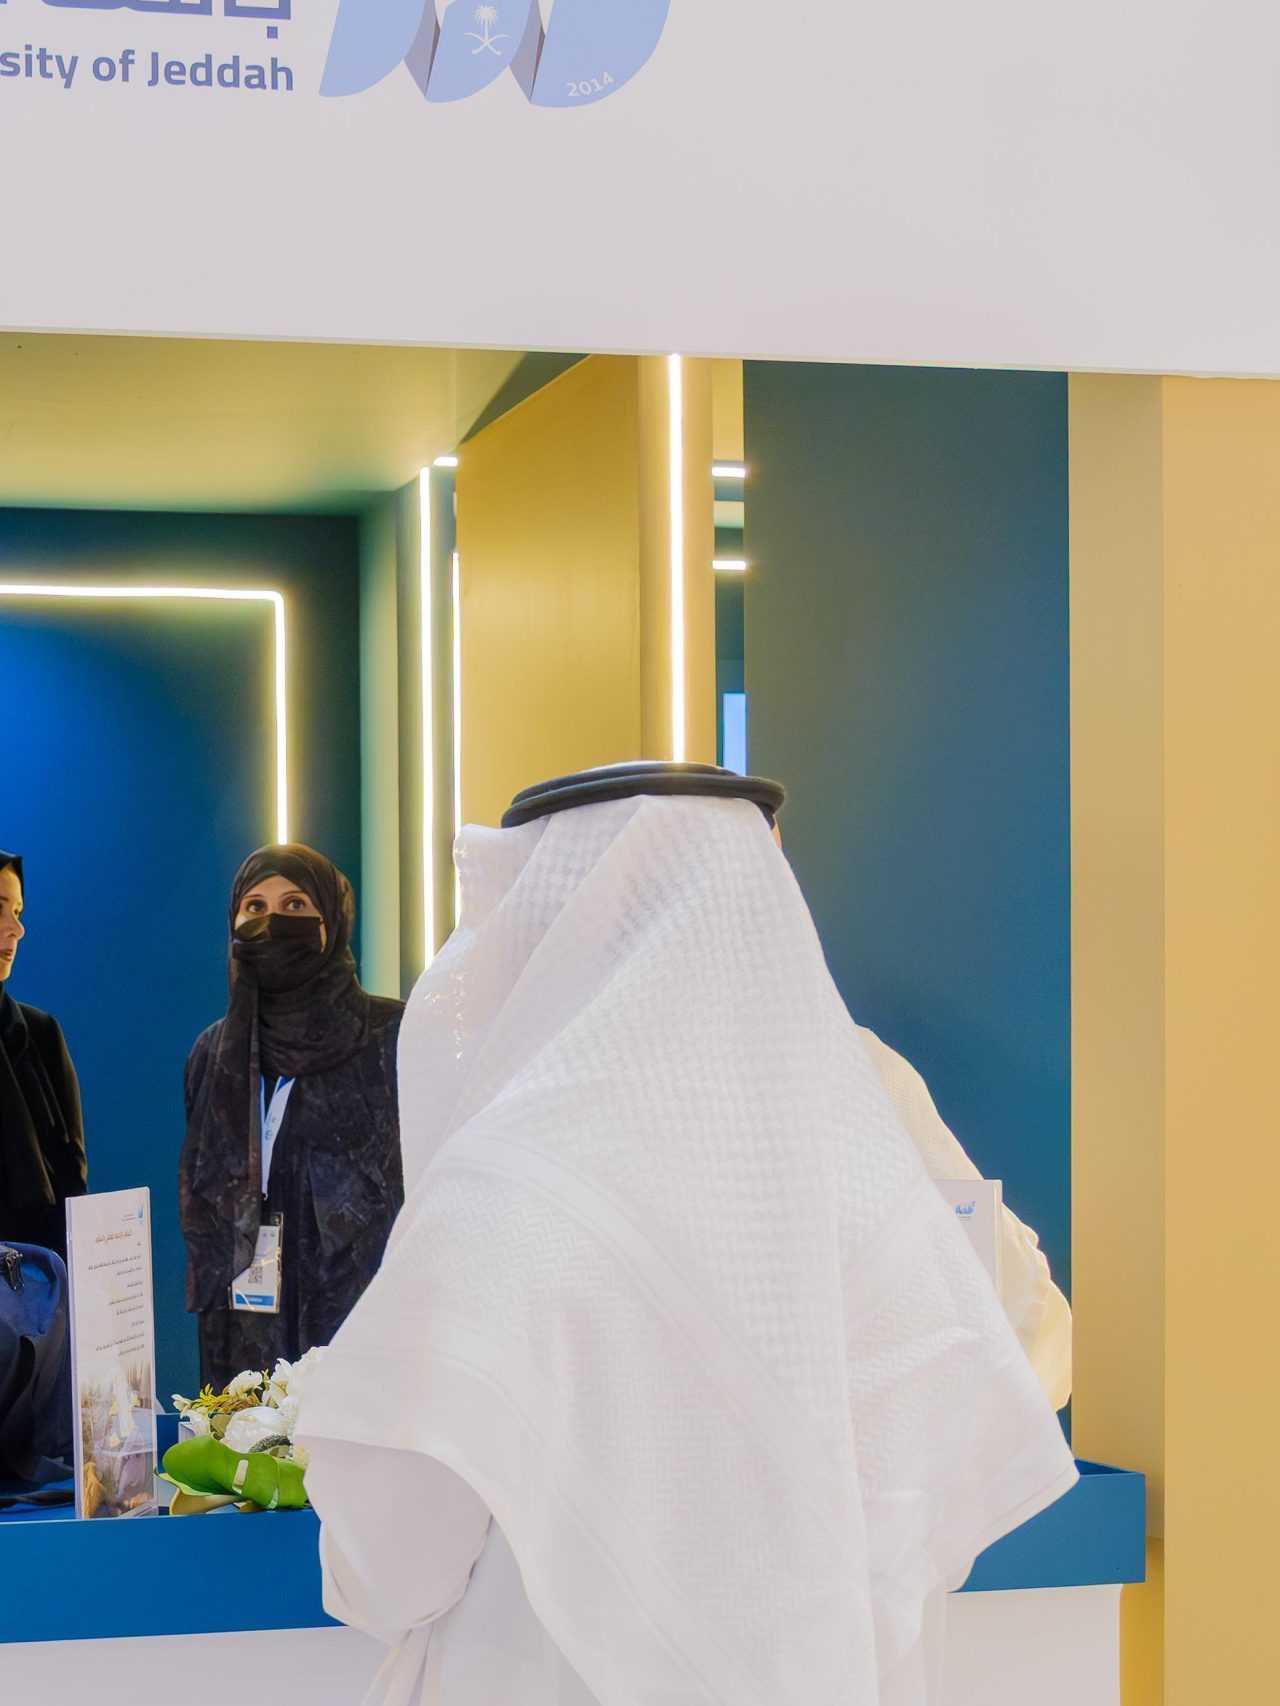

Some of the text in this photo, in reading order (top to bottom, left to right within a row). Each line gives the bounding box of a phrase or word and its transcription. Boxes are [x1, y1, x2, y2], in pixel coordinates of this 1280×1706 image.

[92, 49, 135, 82] of
[148, 52, 294, 91] Jeddah
[566, 71, 614, 97] 2014
